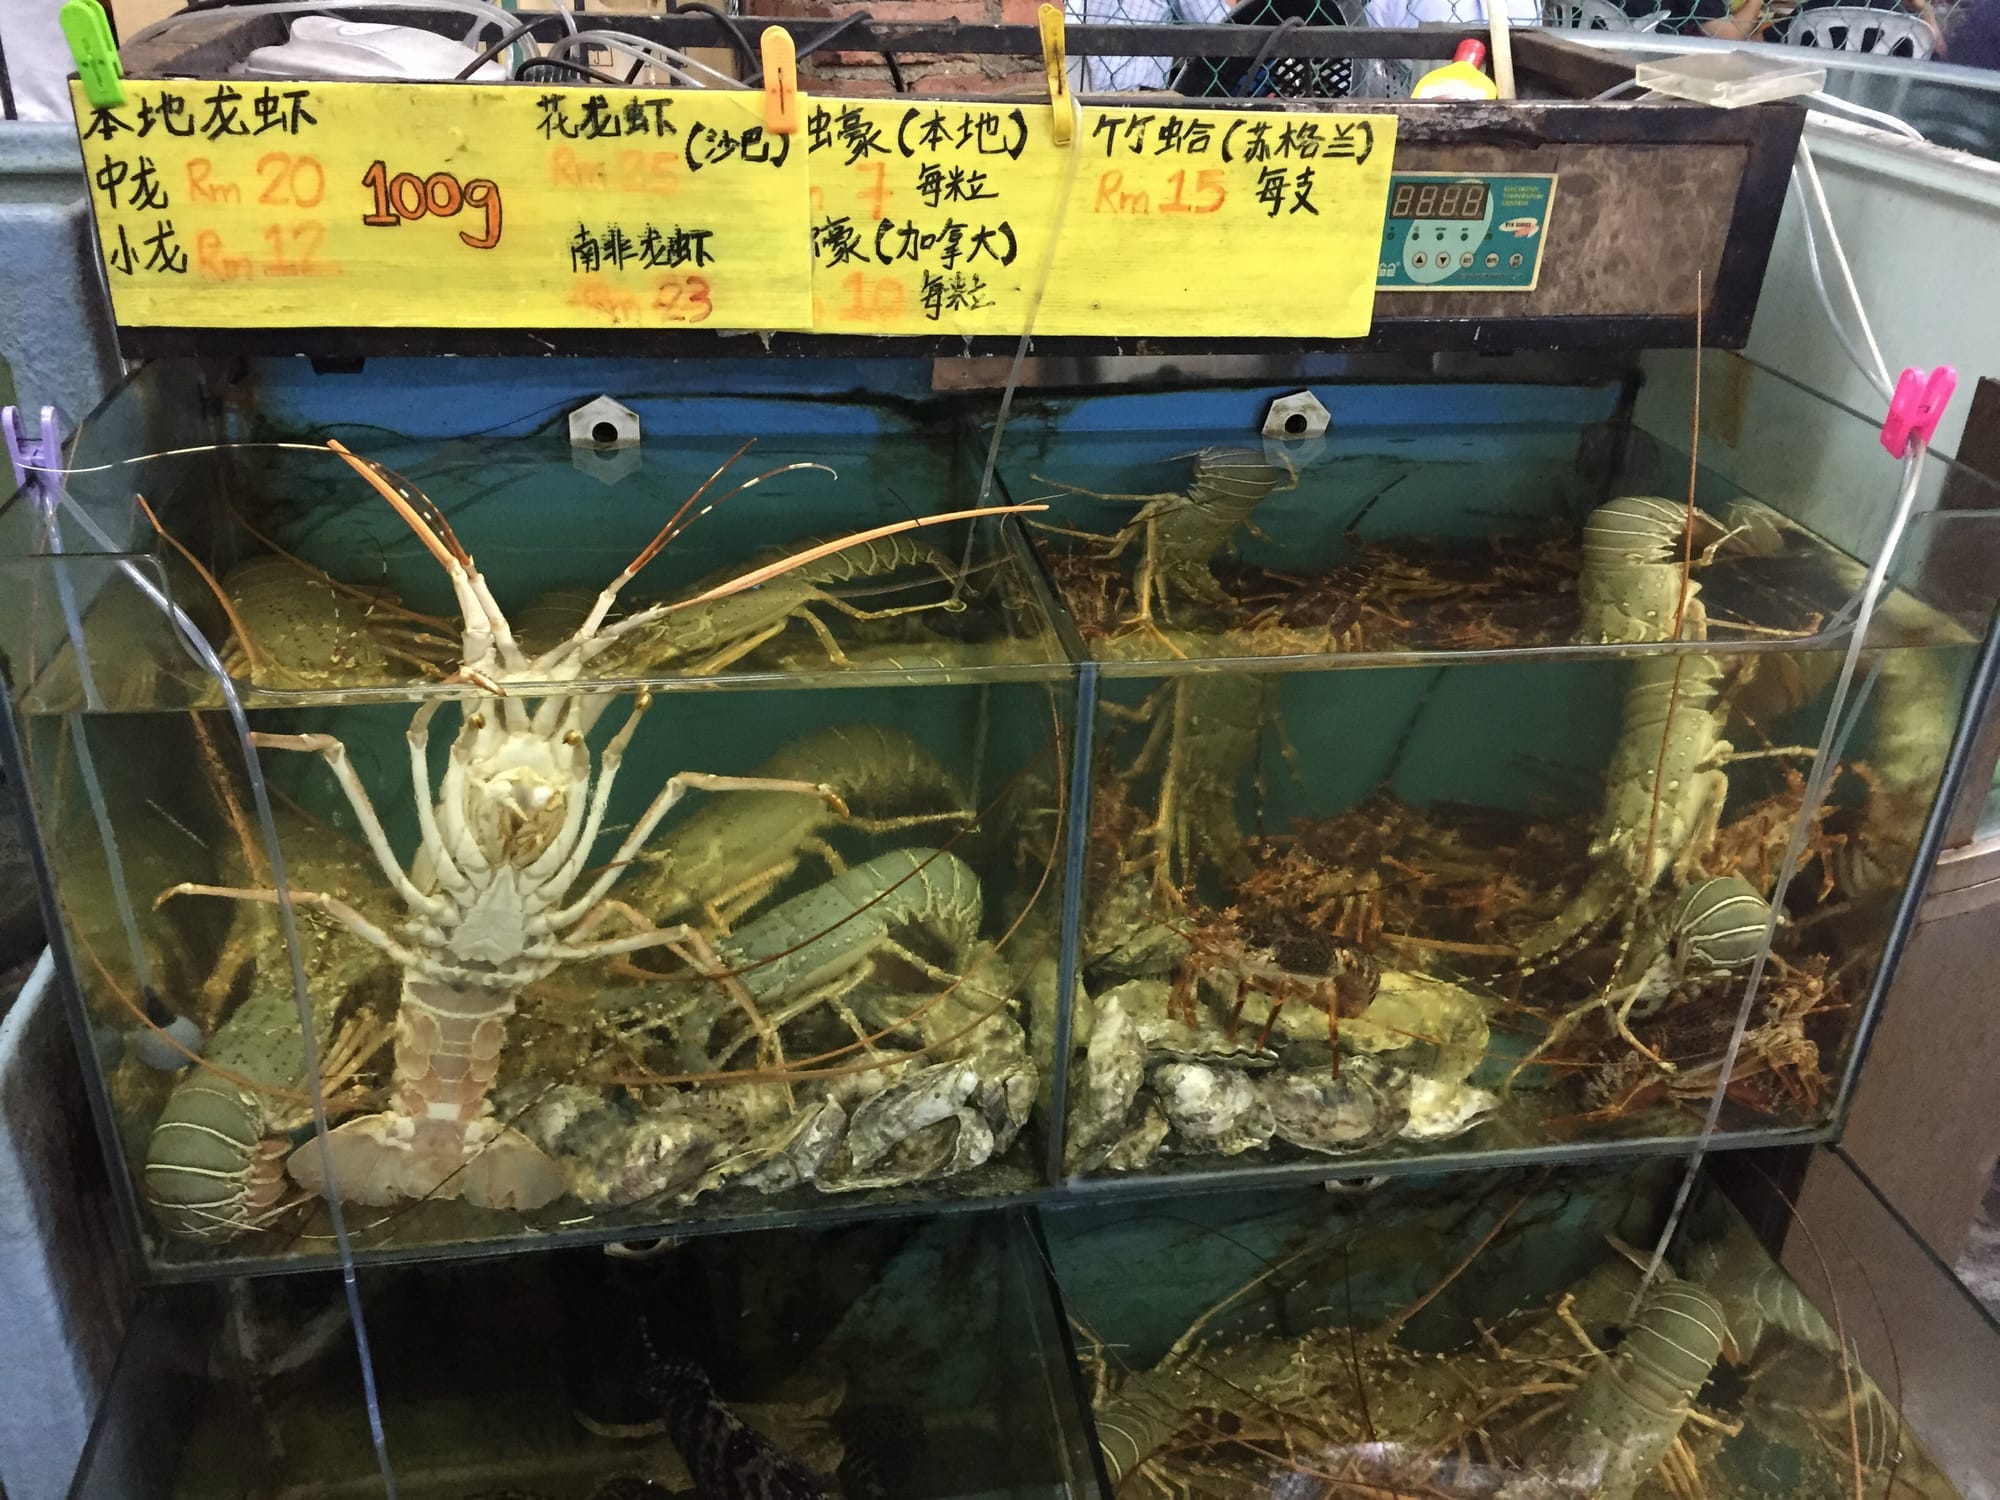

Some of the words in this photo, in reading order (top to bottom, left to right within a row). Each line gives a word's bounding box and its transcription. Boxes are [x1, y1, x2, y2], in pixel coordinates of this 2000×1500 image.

[83, 85, 318, 140] 本地龙虾
[96, 154, 169, 211] 中龙
[256, 151, 326, 208] 20
[362, 160, 502, 249] 100g
[916, 163, 999, 208] 每粒
[1157, 169, 1226, 214] 15
[1255, 166, 1320, 218] 每支
[111, 220, 188, 275] 小龙
[263, 222, 340, 277] 12
[571, 217, 715, 273] 南非龙虾
[655, 276, 713, 323] 23
[919, 270, 996, 321] 每粒
